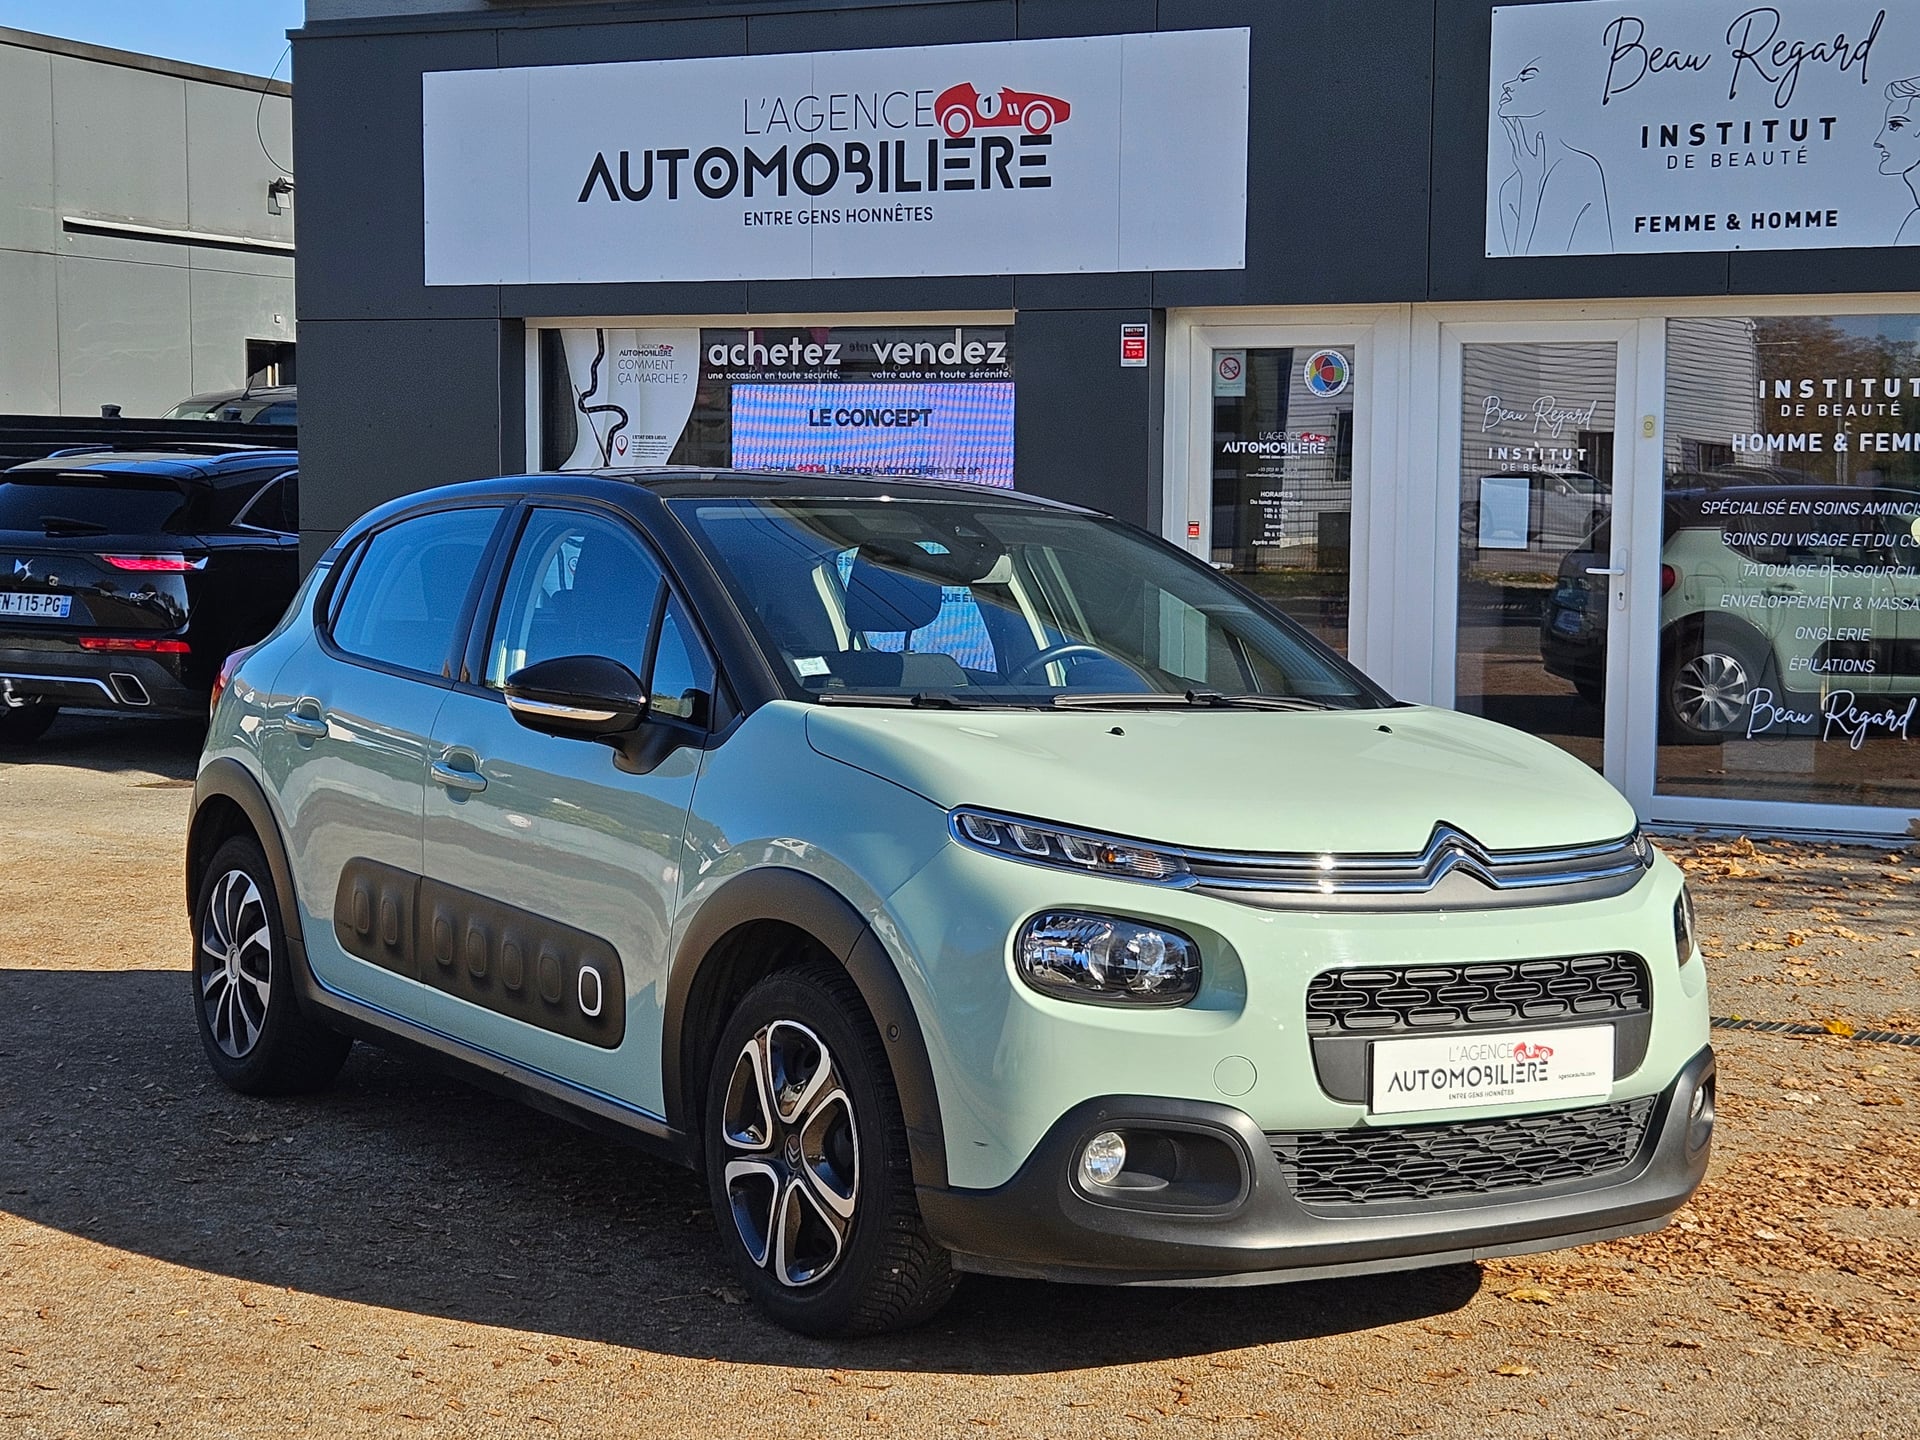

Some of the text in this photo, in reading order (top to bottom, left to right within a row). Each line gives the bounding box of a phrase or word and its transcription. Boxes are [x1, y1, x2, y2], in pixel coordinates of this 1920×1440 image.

[1603, 7, 1885, 108] Beau Regard
[743, 87, 933, 136] L'AGENCE
[1641, 117, 1838, 149] INSTITUT
[1667, 147, 1808, 169] DE BEAUTÉ
[743, 202, 933, 227] ENTRE GENS HONNÊTES
[1634, 209, 1839, 233] FEMME & HOMME
[707, 331, 841, 366] achetez
[872, 328, 1007, 365] vendez
[618, 360, 674, 370] COMMENT
[872, 368, 1012, 379] votre auto en toute sérénité.
[618, 373, 688, 385] ÇA MARCHE ?
[707, 370, 841, 381] une occasion en toute sécurité.
[1759, 377, 1920, 399] INSTITUT
[809, 408, 932, 427] LE CONCEPT
[1481, 395, 1597, 439] Beau Regard
[1781, 400, 1902, 418] DE BEAUTÉ
[1259, 431, 1301, 441] L'AGENCE
[1732, 433, 1822, 453] HOMME
[1834, 432, 1849, 453] &
[1488, 447, 1587, 461] INSTITUT
[1501, 463, 1516, 471] DE
[1701, 499, 1786, 515] SPÉCIALISÉ
[1789, 502, 1810, 515] EN
[1813, 501, 1860, 515] SOINS
[1721, 532, 1767, 546] SOINS
[1771, 533, 1793, 546] DU
[1796, 533, 1849, 547] VISAGE
[1851, 534, 1872, 547] ET
[1874, 534, 1896, 547] DU
[1743, 563, 1815, 578] TATOUAGE
[1819, 565, 1849, 578] DES
[1720, 594, 1851, 609] ENVELOPPEMENT
[1853, 596, 1863, 609] &
[1795, 627, 1872, 642] ONGLERIE
[1789, 655, 1876, 673] ÉPILATIONS
[1745, 688, 1917, 750] Beau Regard
[1449, 1042, 1514, 1063] L'AGENCE
[1449, 1088, 1514, 1100] ENTRE GENS HONNÊTES
